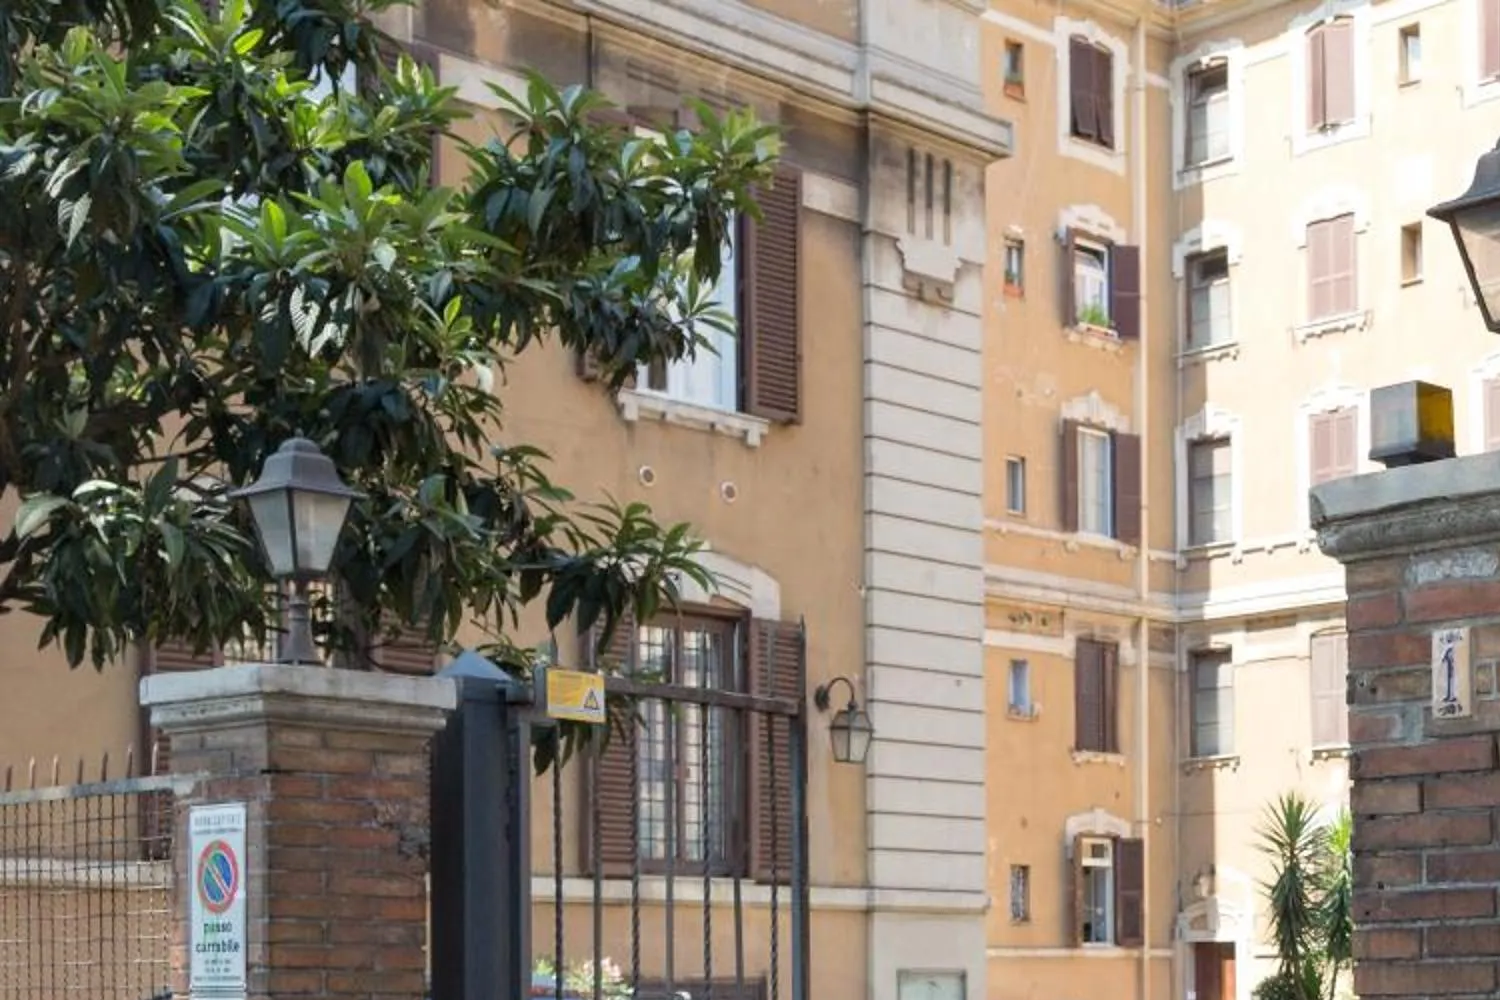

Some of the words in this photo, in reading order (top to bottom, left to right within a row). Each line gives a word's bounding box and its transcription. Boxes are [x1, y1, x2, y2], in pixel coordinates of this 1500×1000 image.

[1442, 647, 1457, 702] 1
[203, 921, 233, 937] passo
[195, 938, 241, 954] carrabile
